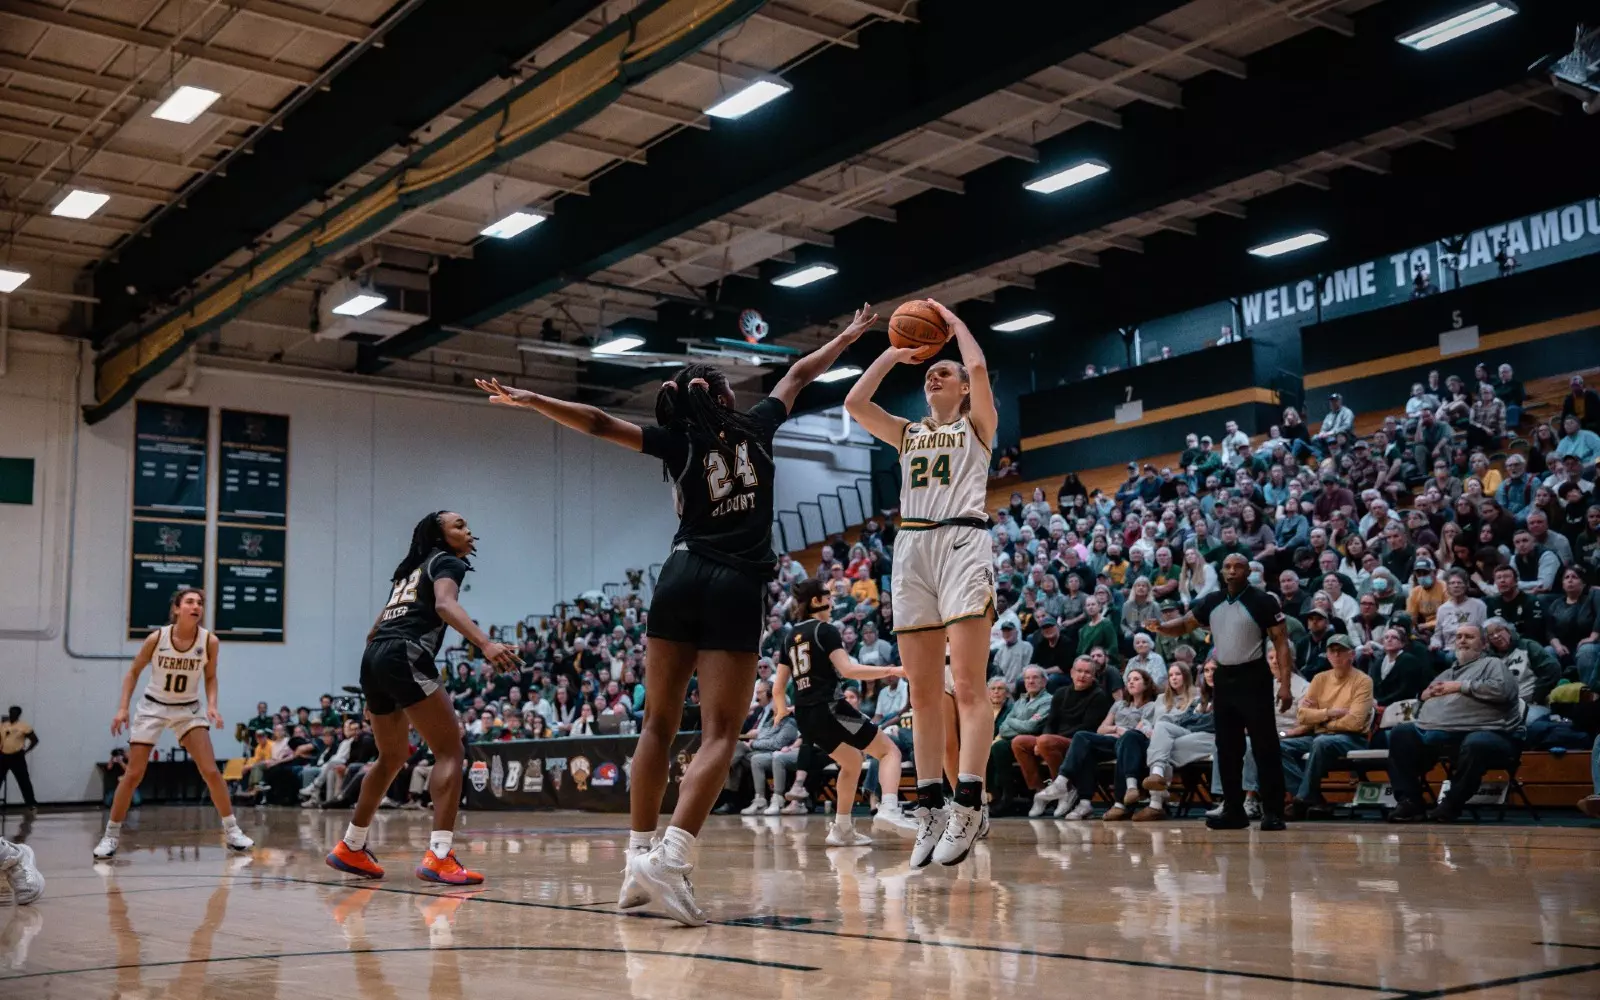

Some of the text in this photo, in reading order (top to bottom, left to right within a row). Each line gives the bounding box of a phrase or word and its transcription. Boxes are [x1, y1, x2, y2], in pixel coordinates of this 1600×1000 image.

[1241, 261, 1377, 327] WELCOME
[1390, 247, 1431, 287] TO
[1452, 310, 1463, 329] 5
[1125, 385, 1134, 402] 7
[703, 440, 758, 502] 24
[910, 454, 951, 490] 24
[386, 568, 422, 608] 22
[157, 655, 202, 672] VERMONT
[788, 641, 811, 678] 15
[164, 673, 188, 693] 10
